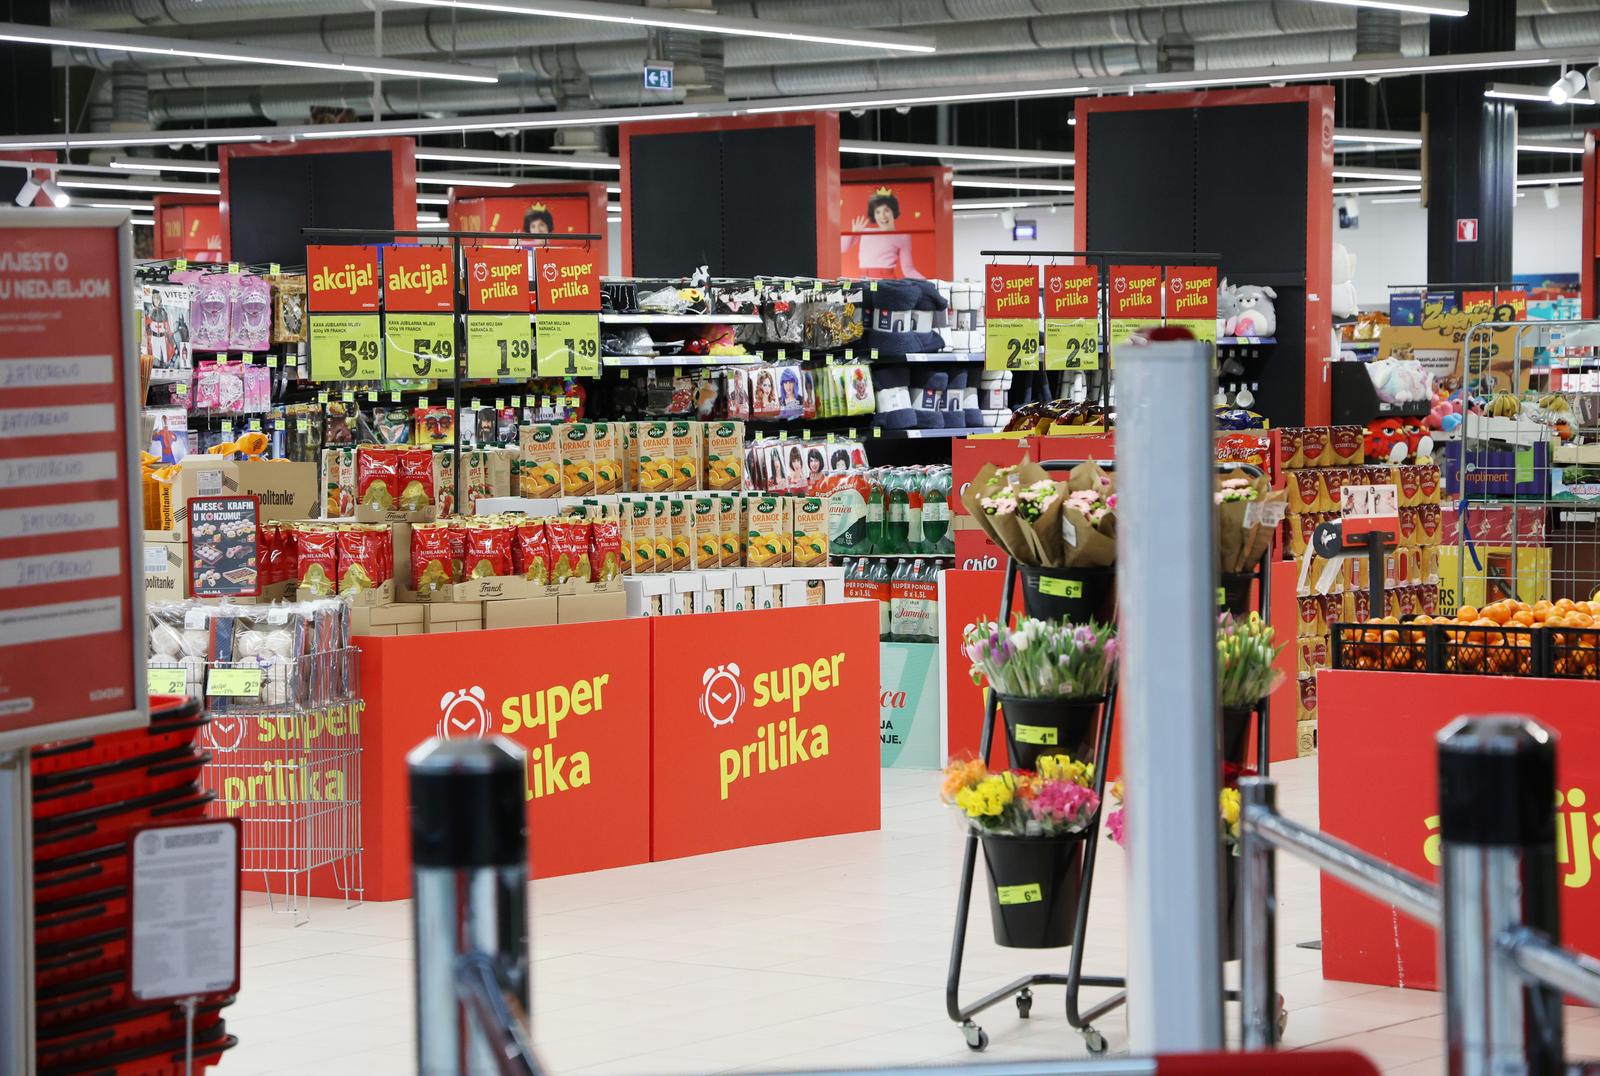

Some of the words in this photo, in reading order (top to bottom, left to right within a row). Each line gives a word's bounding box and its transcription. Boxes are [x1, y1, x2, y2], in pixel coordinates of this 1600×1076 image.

[54, 252, 68, 272] O
[312, 263, 373, 295] akcija!
[389, 263, 449, 295] akcija!
[491, 263, 523, 280] super
[560, 263, 593, 280] super
[14, 278, 111, 299] NEDJELJOM
[1006, 276, 1035, 291] super
[1064, 276, 1093, 291] super
[1128, 277, 1157, 292] super
[1185, 277, 1212, 292] super
[481, 281, 518, 304] prilika
[551, 281, 589, 304] prilika
[997, 292, 1030, 311] prilika
[1055, 292, 1088, 311] prilika
[1119, 293, 1152, 312] prilika
[1176, 293, 1208, 312] prilika
[528, 442, 556, 451] ORANGE
[563, 440, 591, 451] ORANGE
[643, 438, 670, 448] ORANGE
[712, 437, 738, 446] ORANGE
[1455, 471, 1509, 484] Cmpliment
[193, 502, 224, 511] MJESEC
[227, 501, 254, 510] KRAFNI
[193, 512, 199, 521] U
[200, 511, 240, 521] KONZUMU!
[752, 513, 779, 522] ORANGE
[797, 513, 824, 522] ORANGE
[963, 555, 997, 571] Chio
[480, 582, 503, 593] Franck
[753, 652, 845, 713] super
[501, 673, 609, 739] super
[258, 702, 364, 754] super
[720, 717, 830, 801] prilika
[524, 743, 592, 802] lika
[224, 757, 344, 818] prilika
